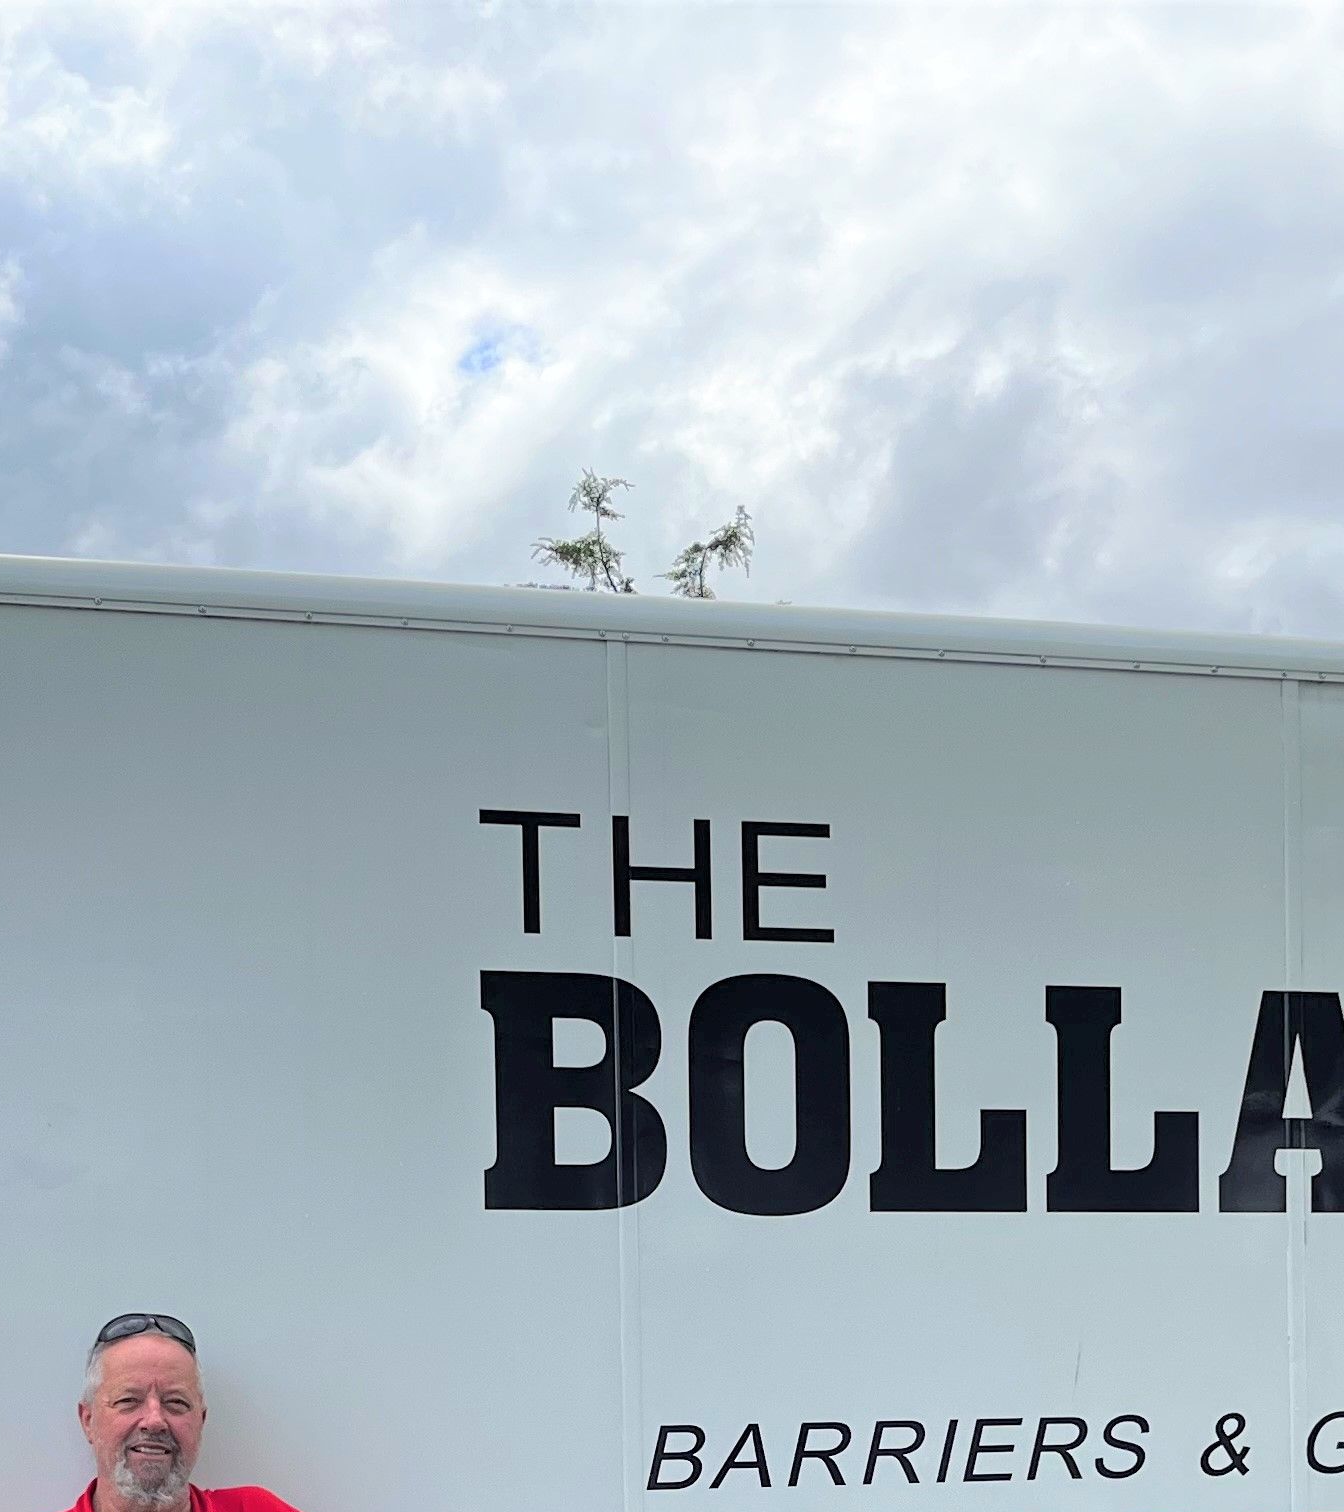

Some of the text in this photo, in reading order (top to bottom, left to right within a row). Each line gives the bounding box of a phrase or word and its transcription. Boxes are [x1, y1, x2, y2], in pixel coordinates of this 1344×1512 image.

[479, 809, 834, 943] THE
[647, 1415, 1149, 1490] BARRIERS
[1201, 1413, 1250, 1476] &
